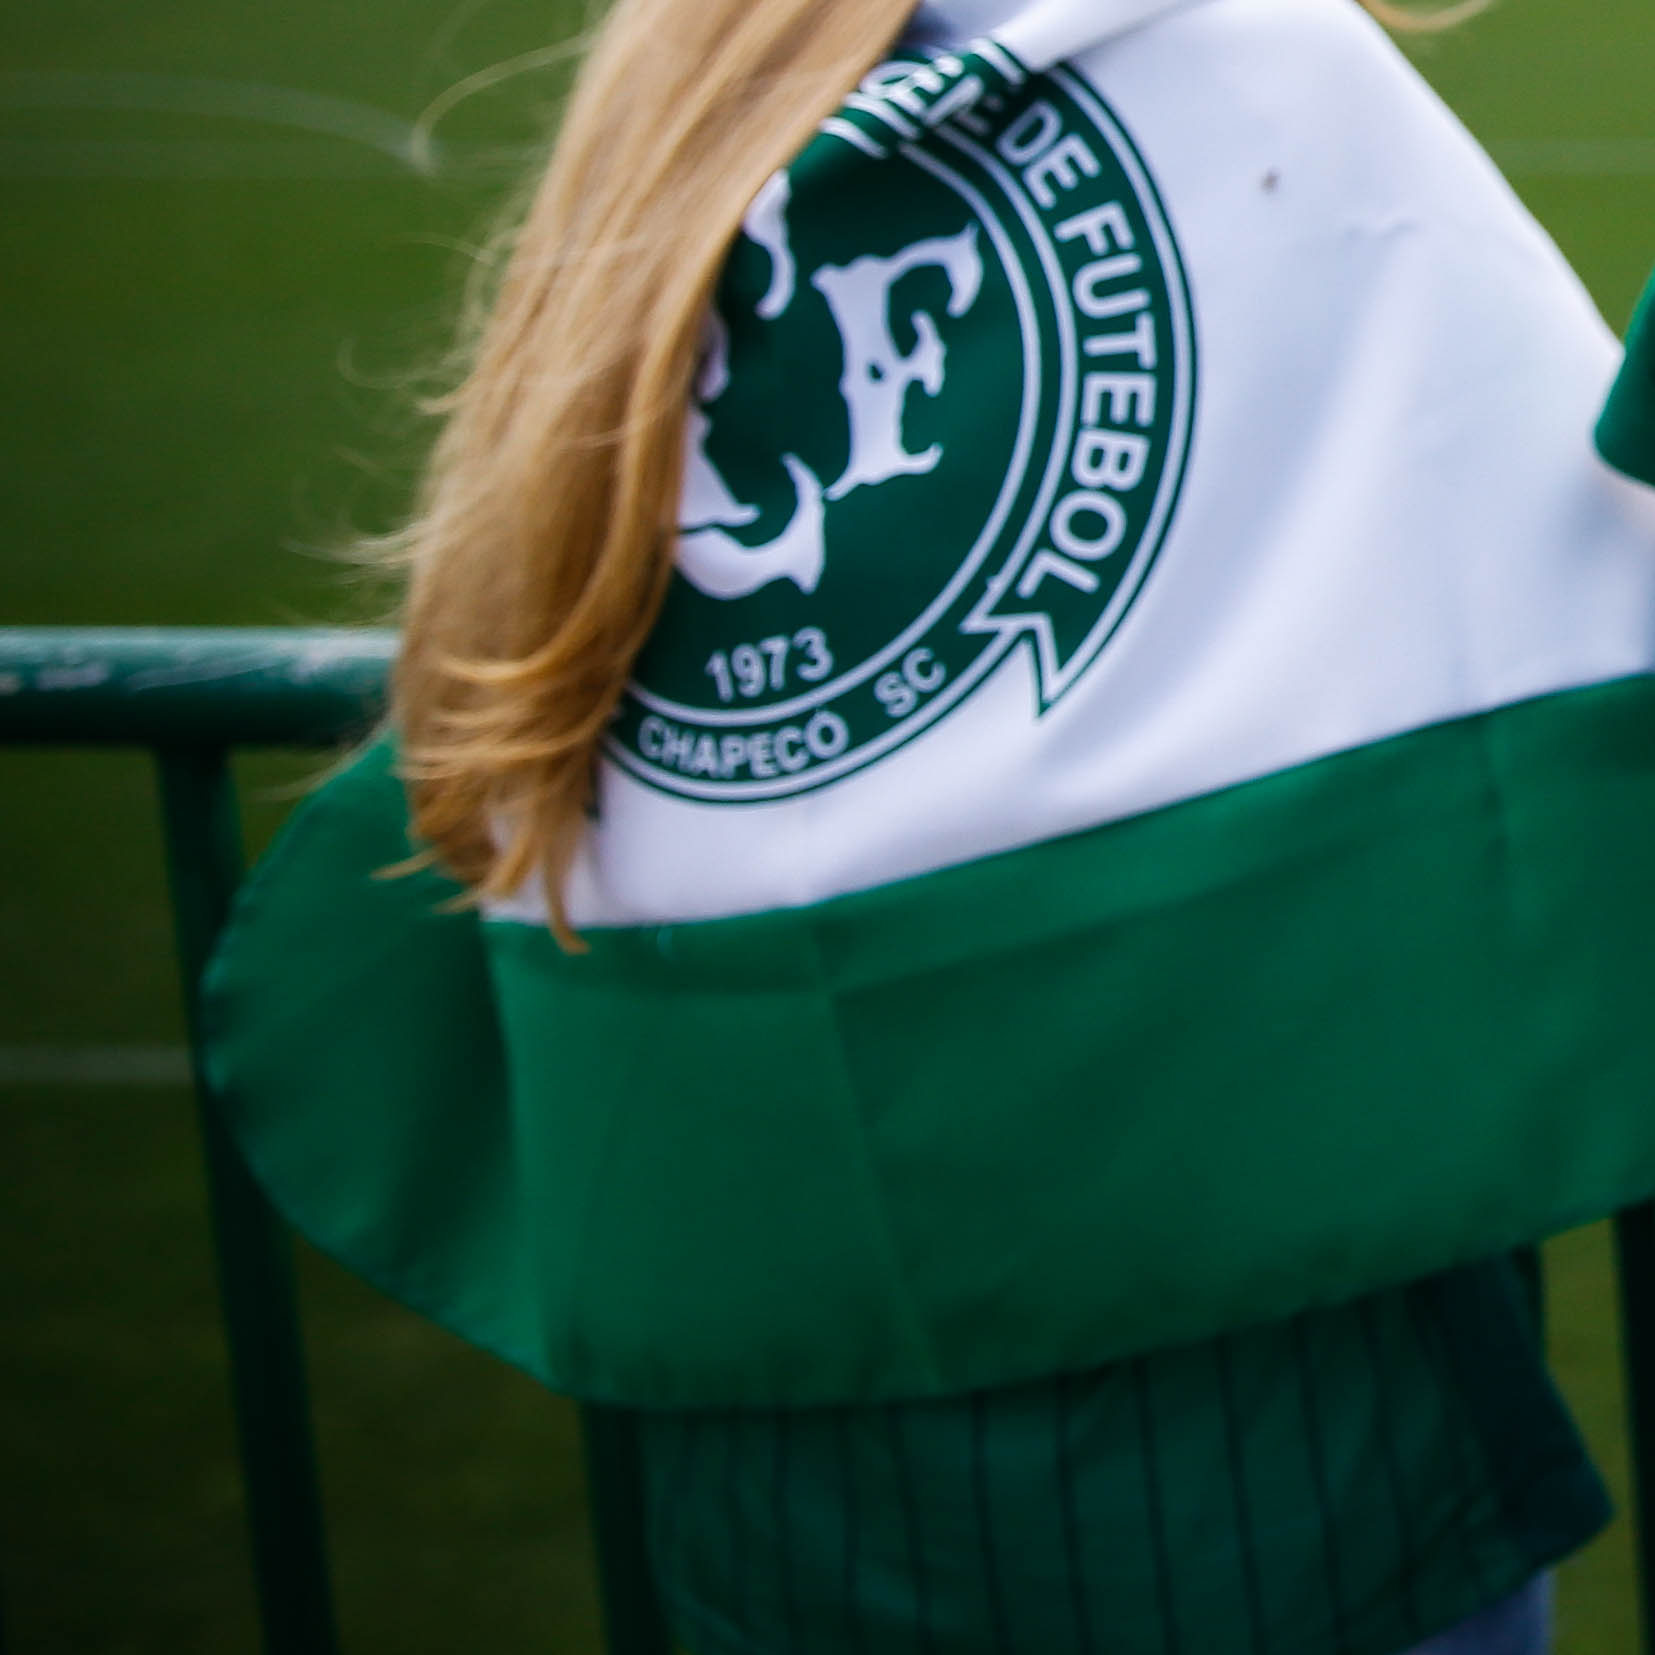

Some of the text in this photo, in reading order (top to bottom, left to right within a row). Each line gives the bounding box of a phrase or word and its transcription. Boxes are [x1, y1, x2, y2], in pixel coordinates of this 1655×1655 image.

[997, 101, 1157, 596] DE FUTEBOL
[705, 626, 833, 703] 1973
[873, 647, 947, 718] SC
